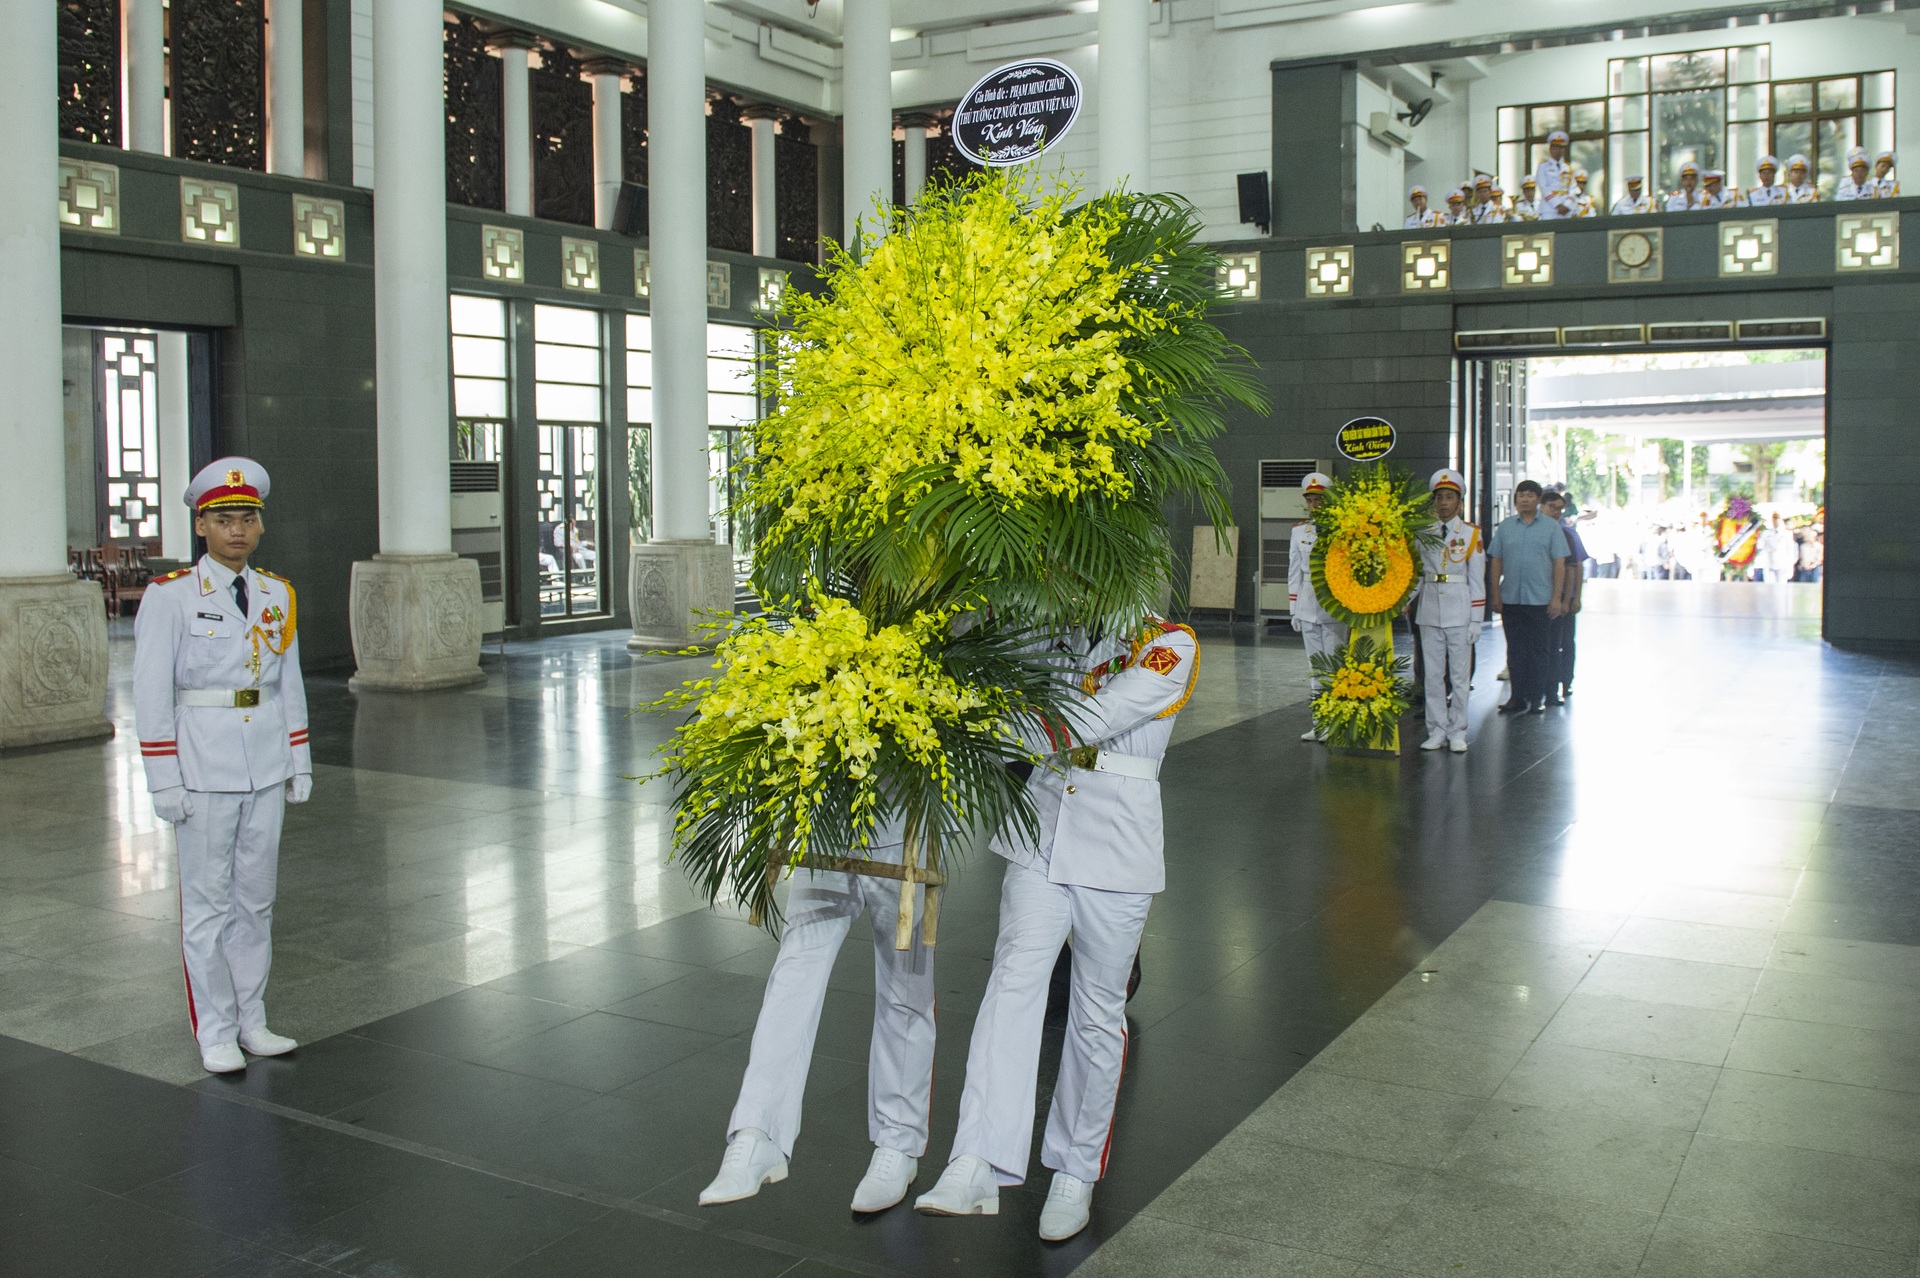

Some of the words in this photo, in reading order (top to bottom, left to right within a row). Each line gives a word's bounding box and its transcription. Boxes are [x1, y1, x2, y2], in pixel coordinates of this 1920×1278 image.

[1010, 83, 1028, 100] PHẠM
[1028, 80, 1045, 95] MINH
[1045, 74, 1066, 92] CHÍNH
[960, 108, 972, 125] THỦ
[972, 105, 993, 123] TƯỚNG
[1001, 101, 1019, 118] NƯỚC
[1046, 96, 1060, 114] VIỆT
[1060, 95, 1076, 110] NAM
[981, 122, 1014, 144] Kính
[1015, 116, 1045, 141] Viếng
